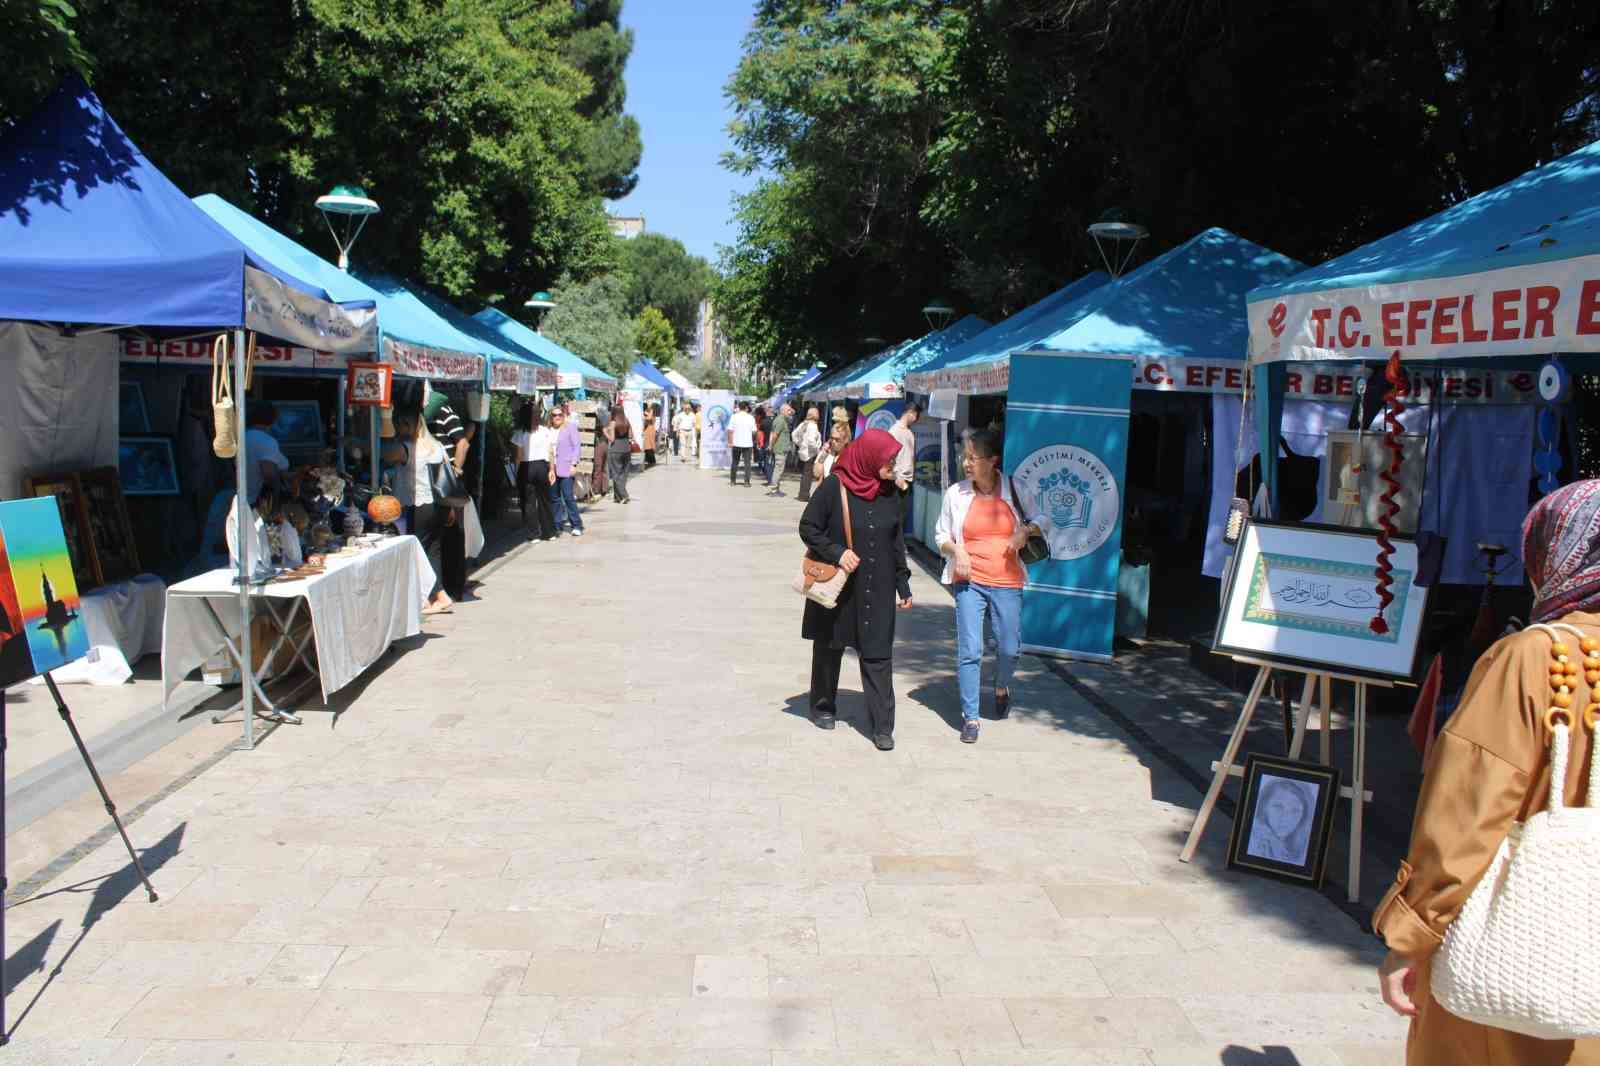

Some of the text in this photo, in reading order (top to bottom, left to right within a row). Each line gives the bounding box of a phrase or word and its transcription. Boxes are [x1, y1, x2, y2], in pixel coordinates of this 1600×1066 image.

[1312, 304, 1371, 349] T.C.
[1381, 285, 1561, 347] EFELER
[1131, 362, 1175, 385] .C.
